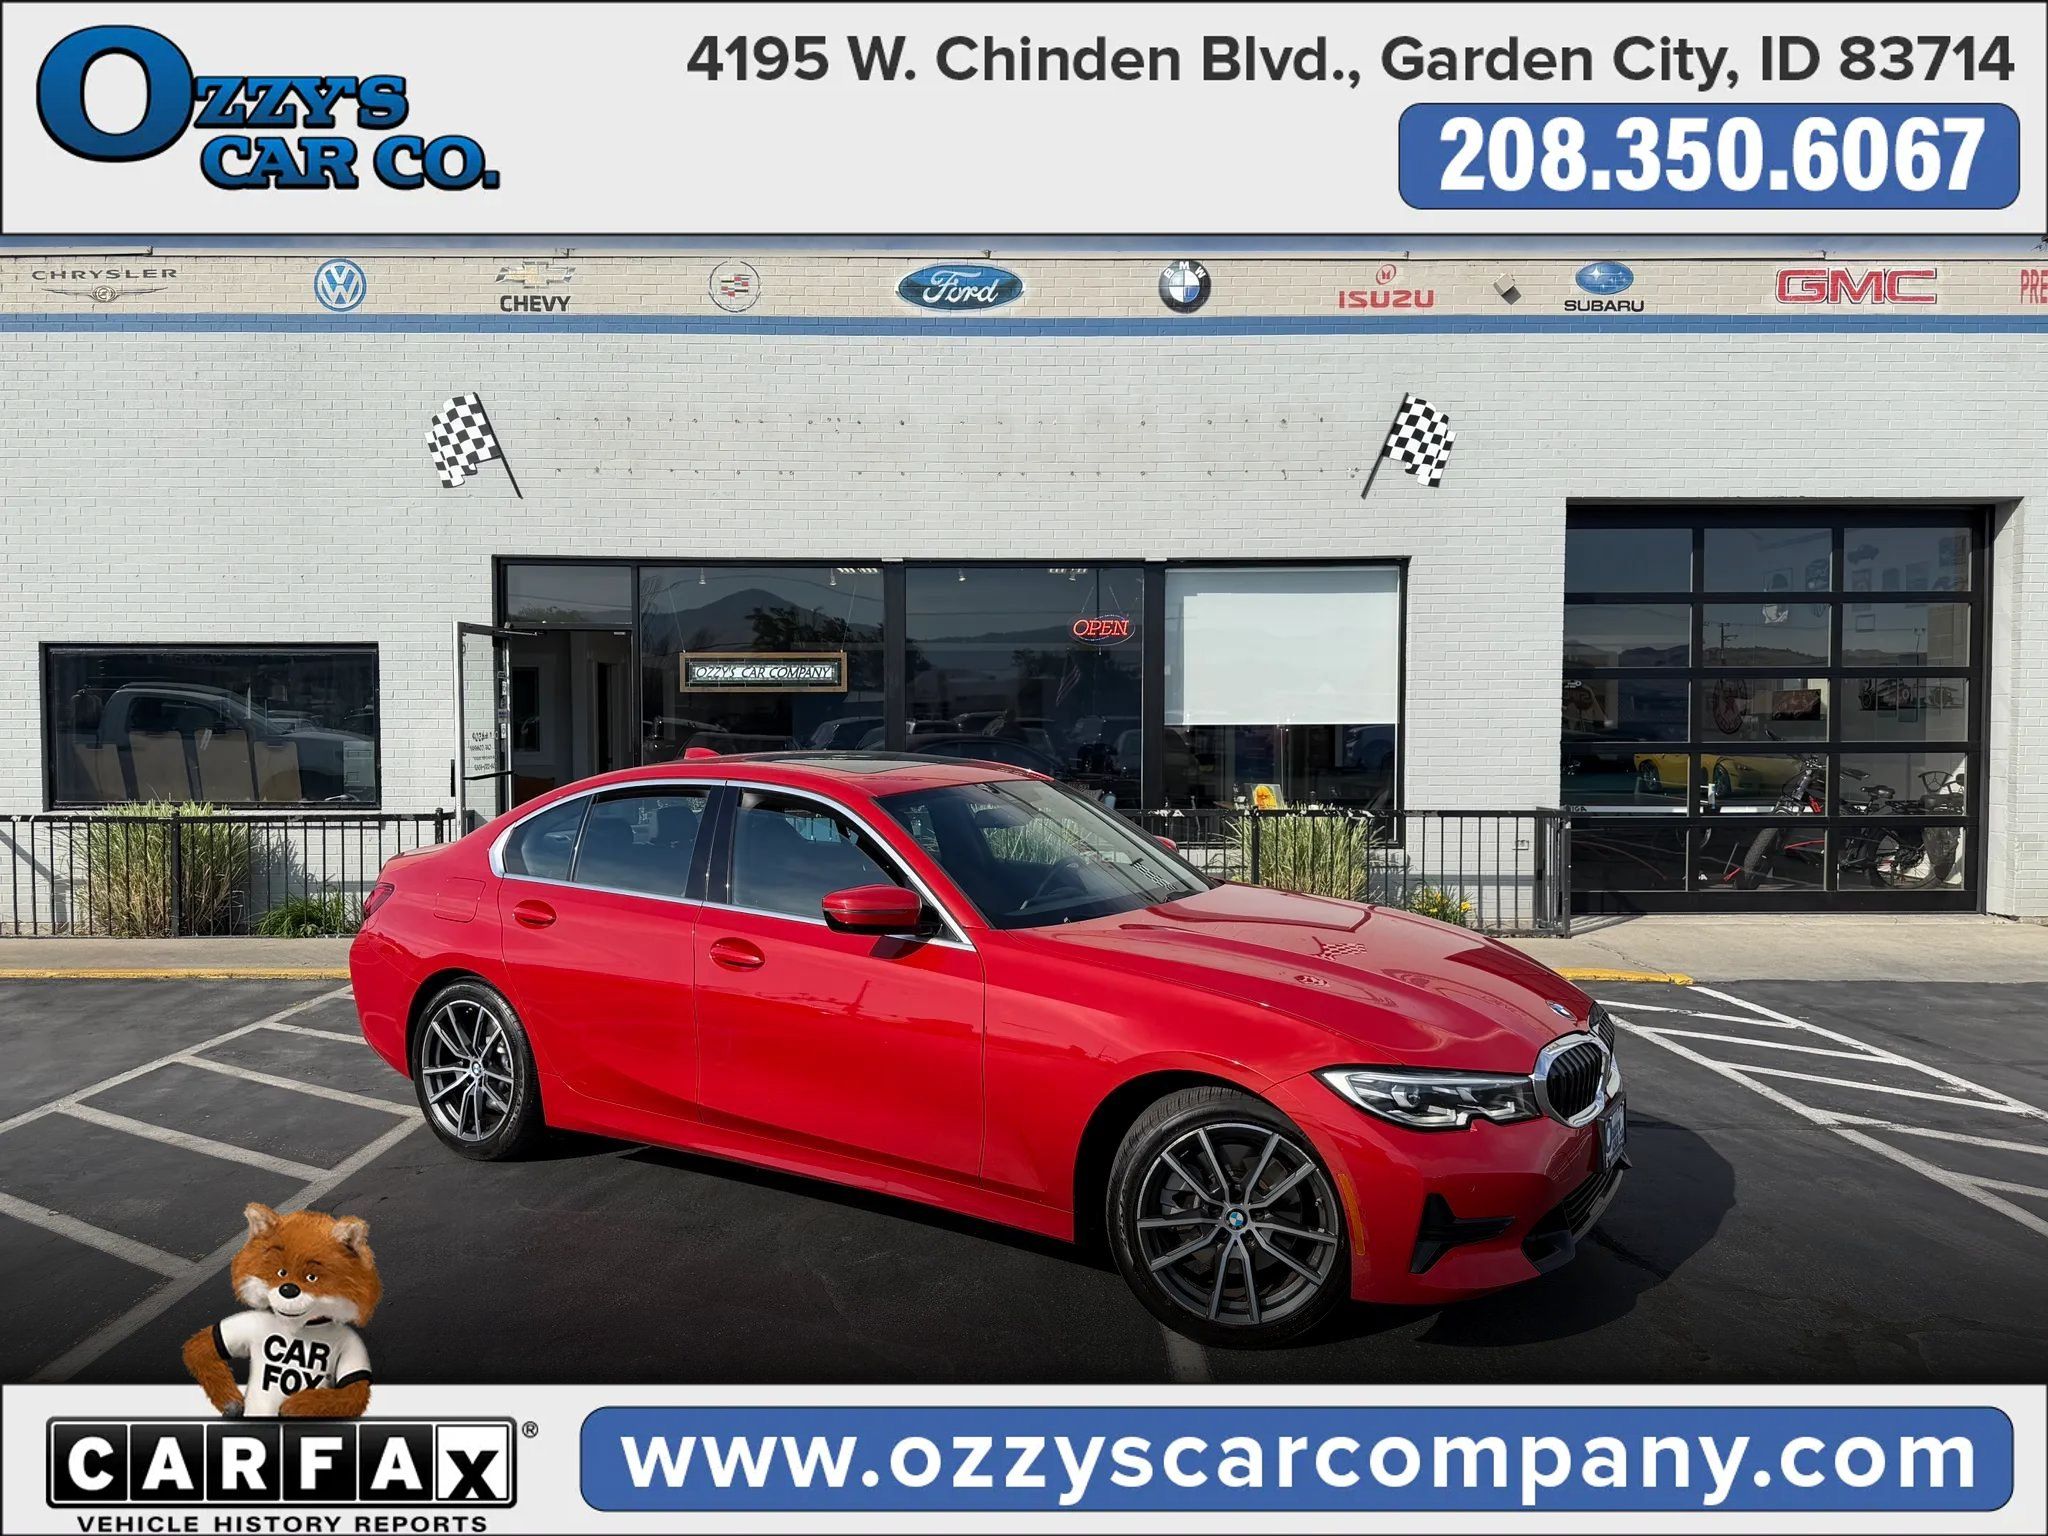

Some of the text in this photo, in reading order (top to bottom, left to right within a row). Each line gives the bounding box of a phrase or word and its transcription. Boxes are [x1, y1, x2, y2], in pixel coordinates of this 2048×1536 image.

[31, 268, 177, 281] CHRYSLER
[1163, 261, 1206, 279] BMW
[922, 270, 999, 303] Ford
[1775, 268, 1937, 304] GMC
[500, 295, 570, 312] CHEVY
[1338, 290, 1434, 309] ISUZU
[1564, 299, 1645, 313] SUBARU
[1072, 619, 1129, 636] OPEN
[696, 666, 831, 679] OZZY'S CAR COMPANY
